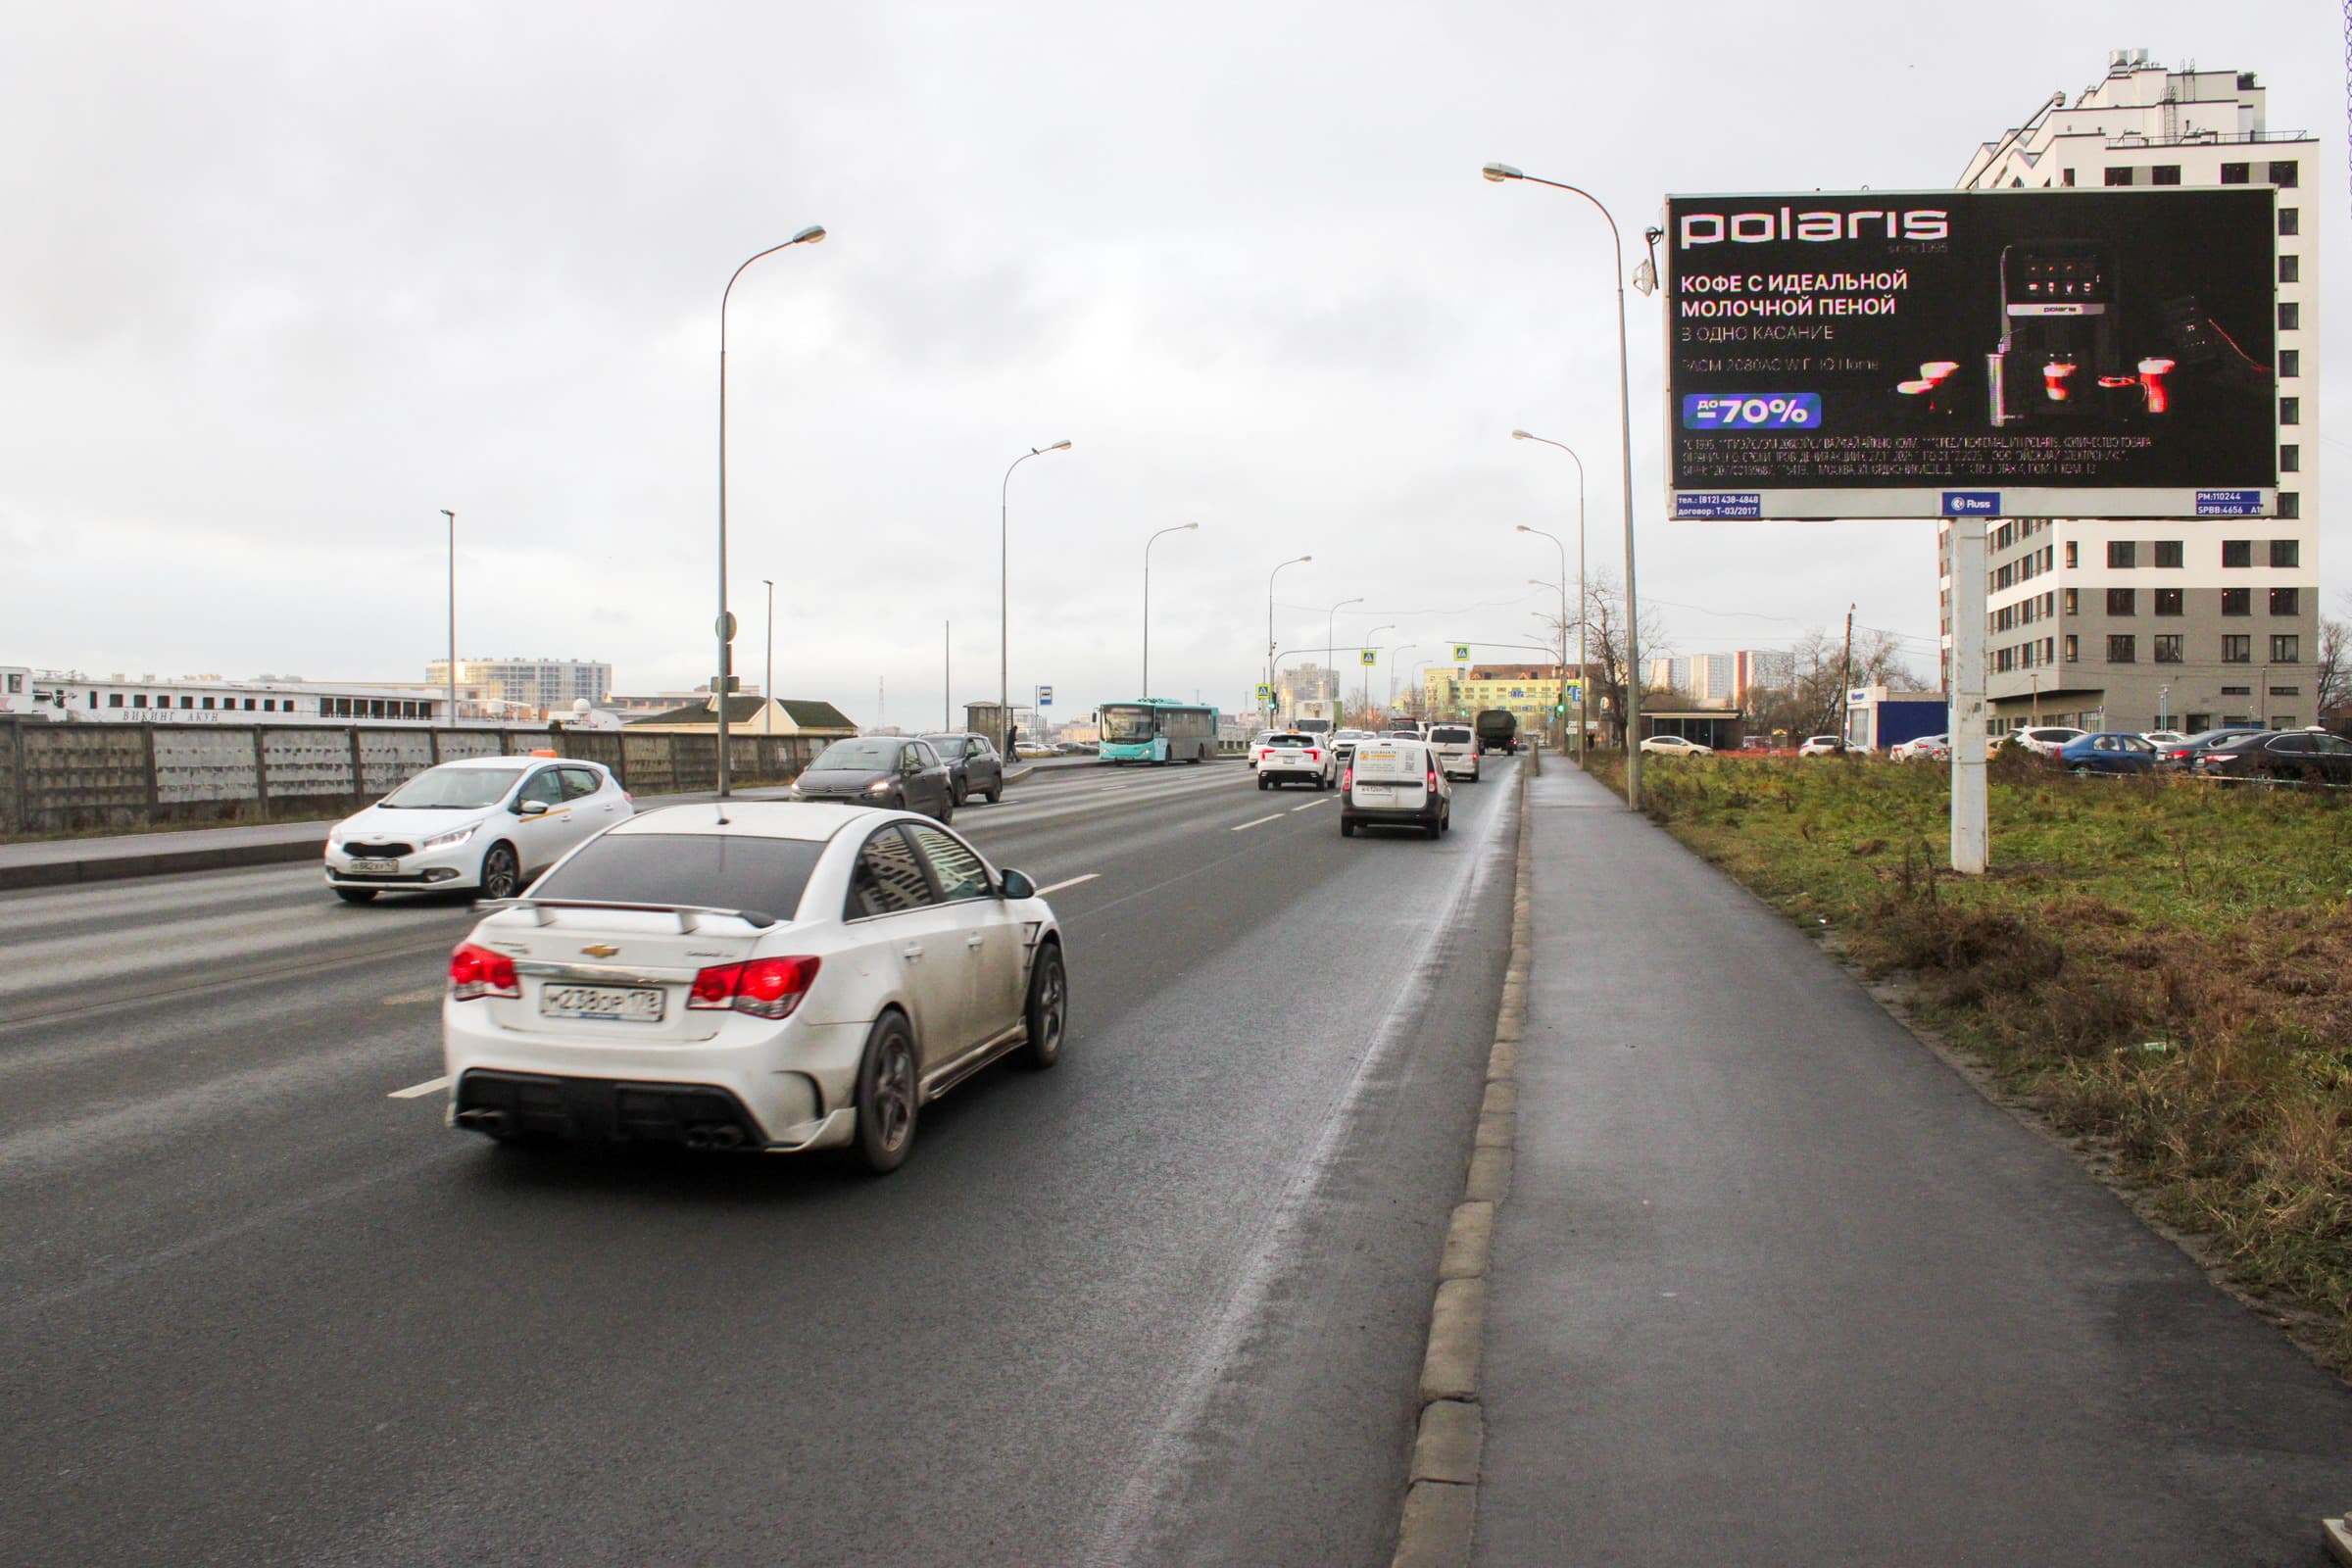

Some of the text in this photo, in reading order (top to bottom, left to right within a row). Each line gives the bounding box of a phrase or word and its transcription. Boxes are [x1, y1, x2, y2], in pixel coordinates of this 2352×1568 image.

[1681, 207, 1948, 250] polaris
[1681, 269, 1908, 294] КОФЕ С ИДЕАЛЬНОЙ
[1681, 295, 1896, 318] МОЛОЧНОЙ ПЕНОЙ
[1696, 326, 1747, 344] ОДНО
[1753, 324, 1835, 341] КАСАНИЕ
[1698, 495, 1720, 504] (812)
[1966, 499, 1991, 509] Russ
[123, 710, 219, 722] ВИКИНГ АКУН
